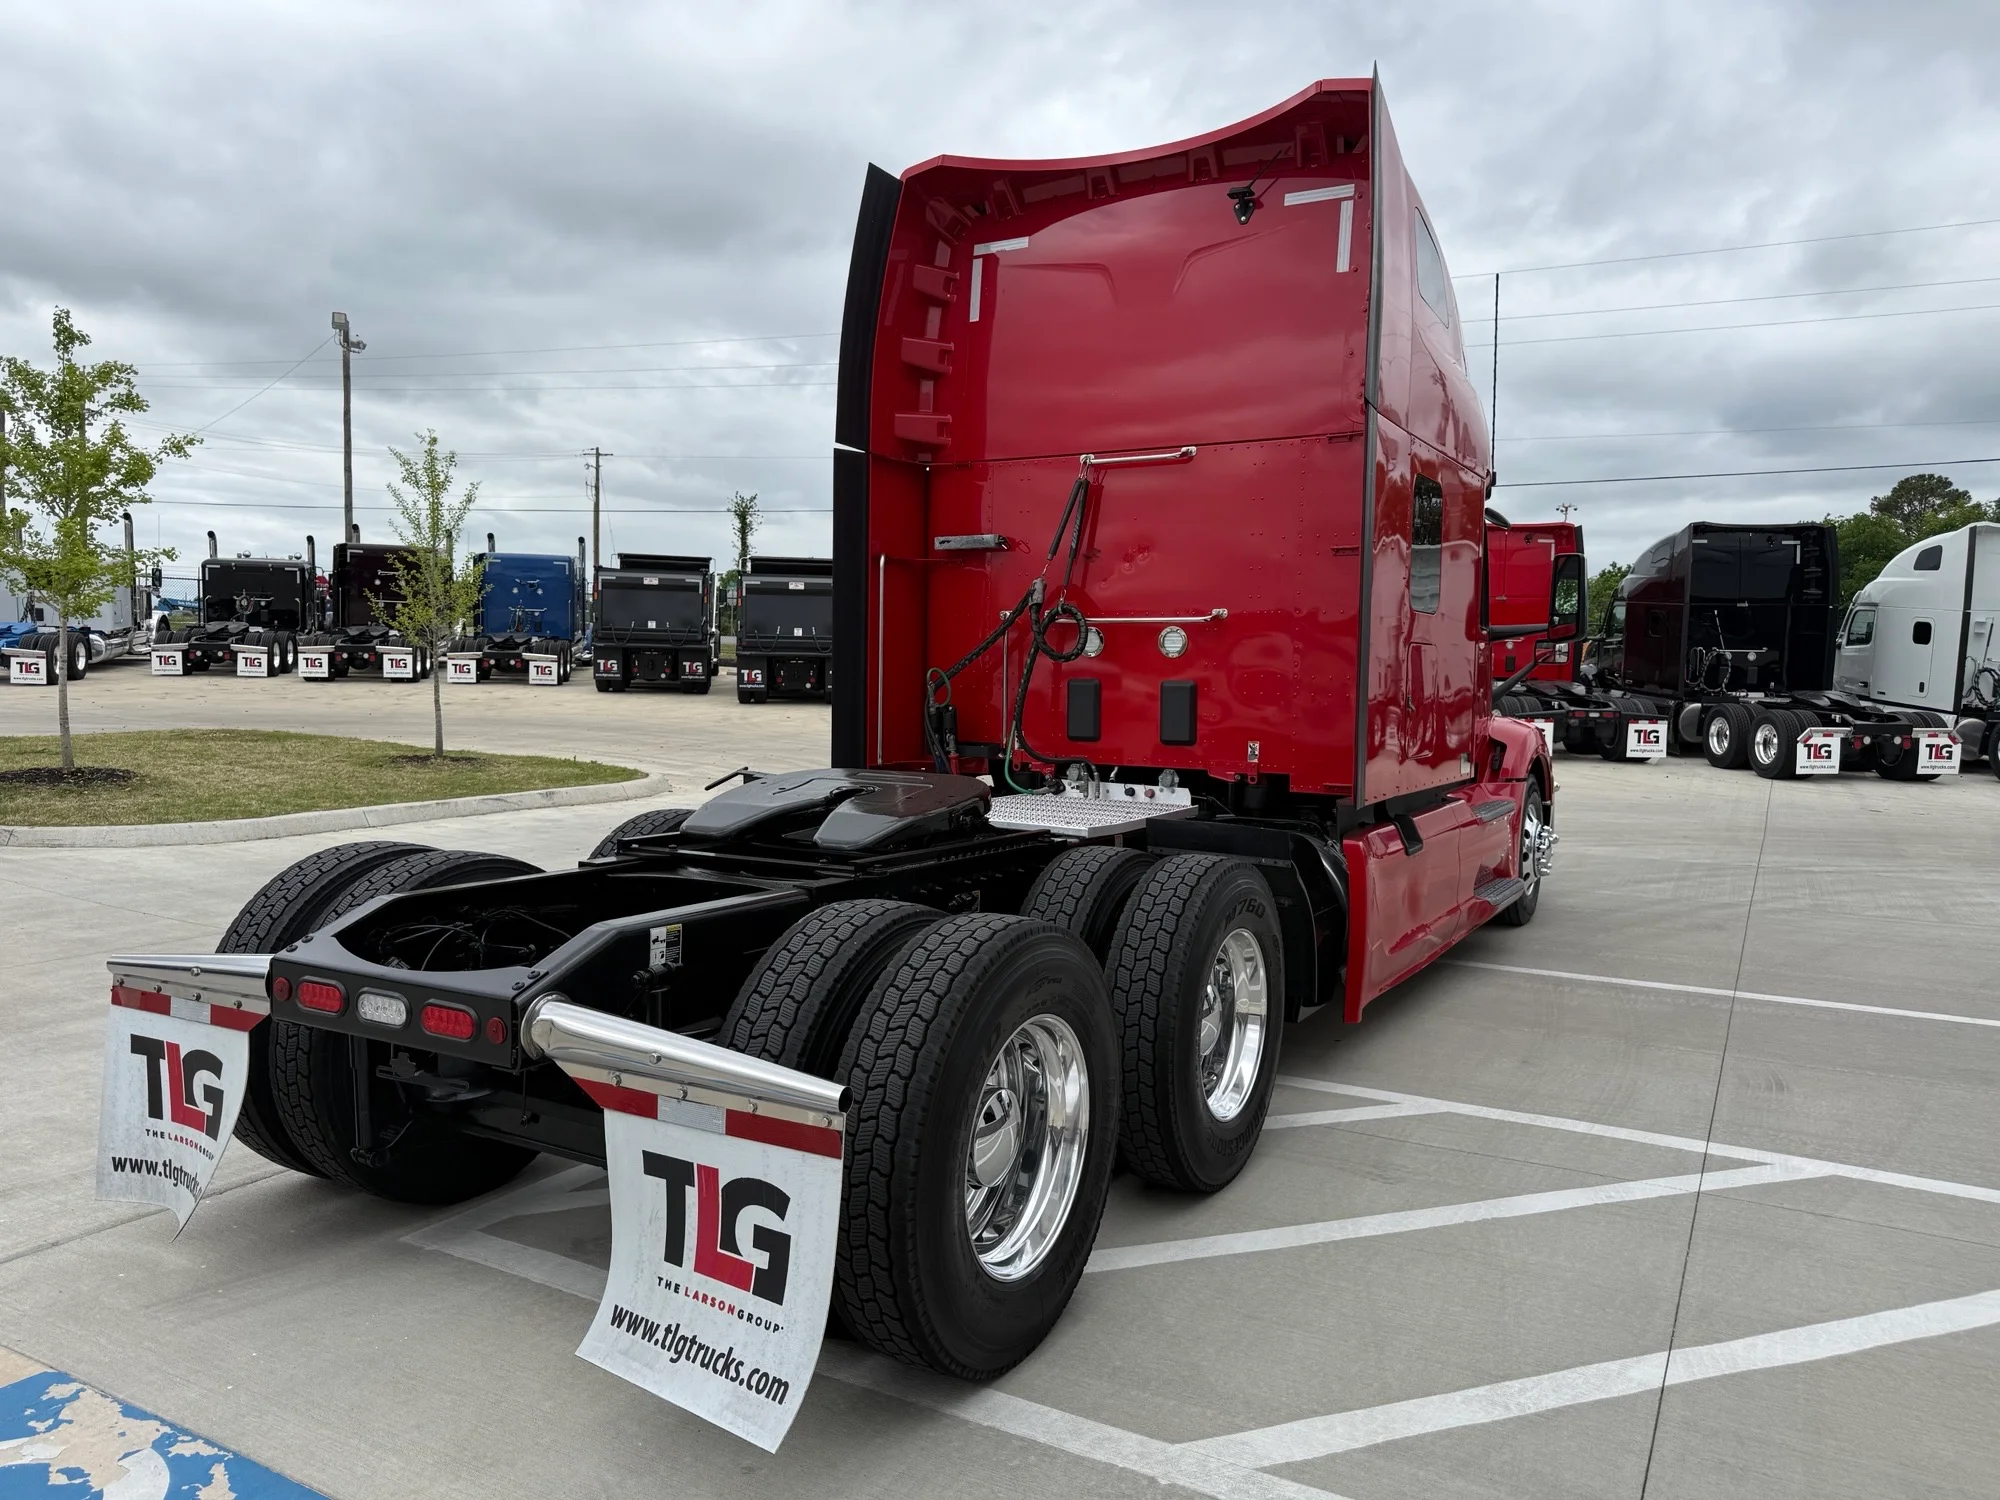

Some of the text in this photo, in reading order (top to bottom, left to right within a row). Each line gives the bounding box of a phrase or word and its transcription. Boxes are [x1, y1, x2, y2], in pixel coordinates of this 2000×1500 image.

[155, 655, 177, 666] TLG
[241, 656, 262, 668] TLG
[302, 657, 323, 668] TLG
[387, 658, 408, 669] TLG
[597, 659, 618, 672] TLG
[16, 661, 40, 674] TLG
[451, 663, 471, 674] TLG
[533, 665, 552, 676] TLG
[682, 661, 703, 675] TLG
[741, 669, 762, 684] TLG
[1634, 729, 1660, 744] TLG
[1803, 744, 1832, 760] TLG
[1925, 744, 1954, 760] TLG
[130, 1033, 225, 1142] TLG
[145, 1128, 165, 1139] THE
[641, 1149, 792, 1306] TLG
[657, 1276, 681, 1294] THE
[610, 1304, 789, 1406] www.tlgtrucks.com
